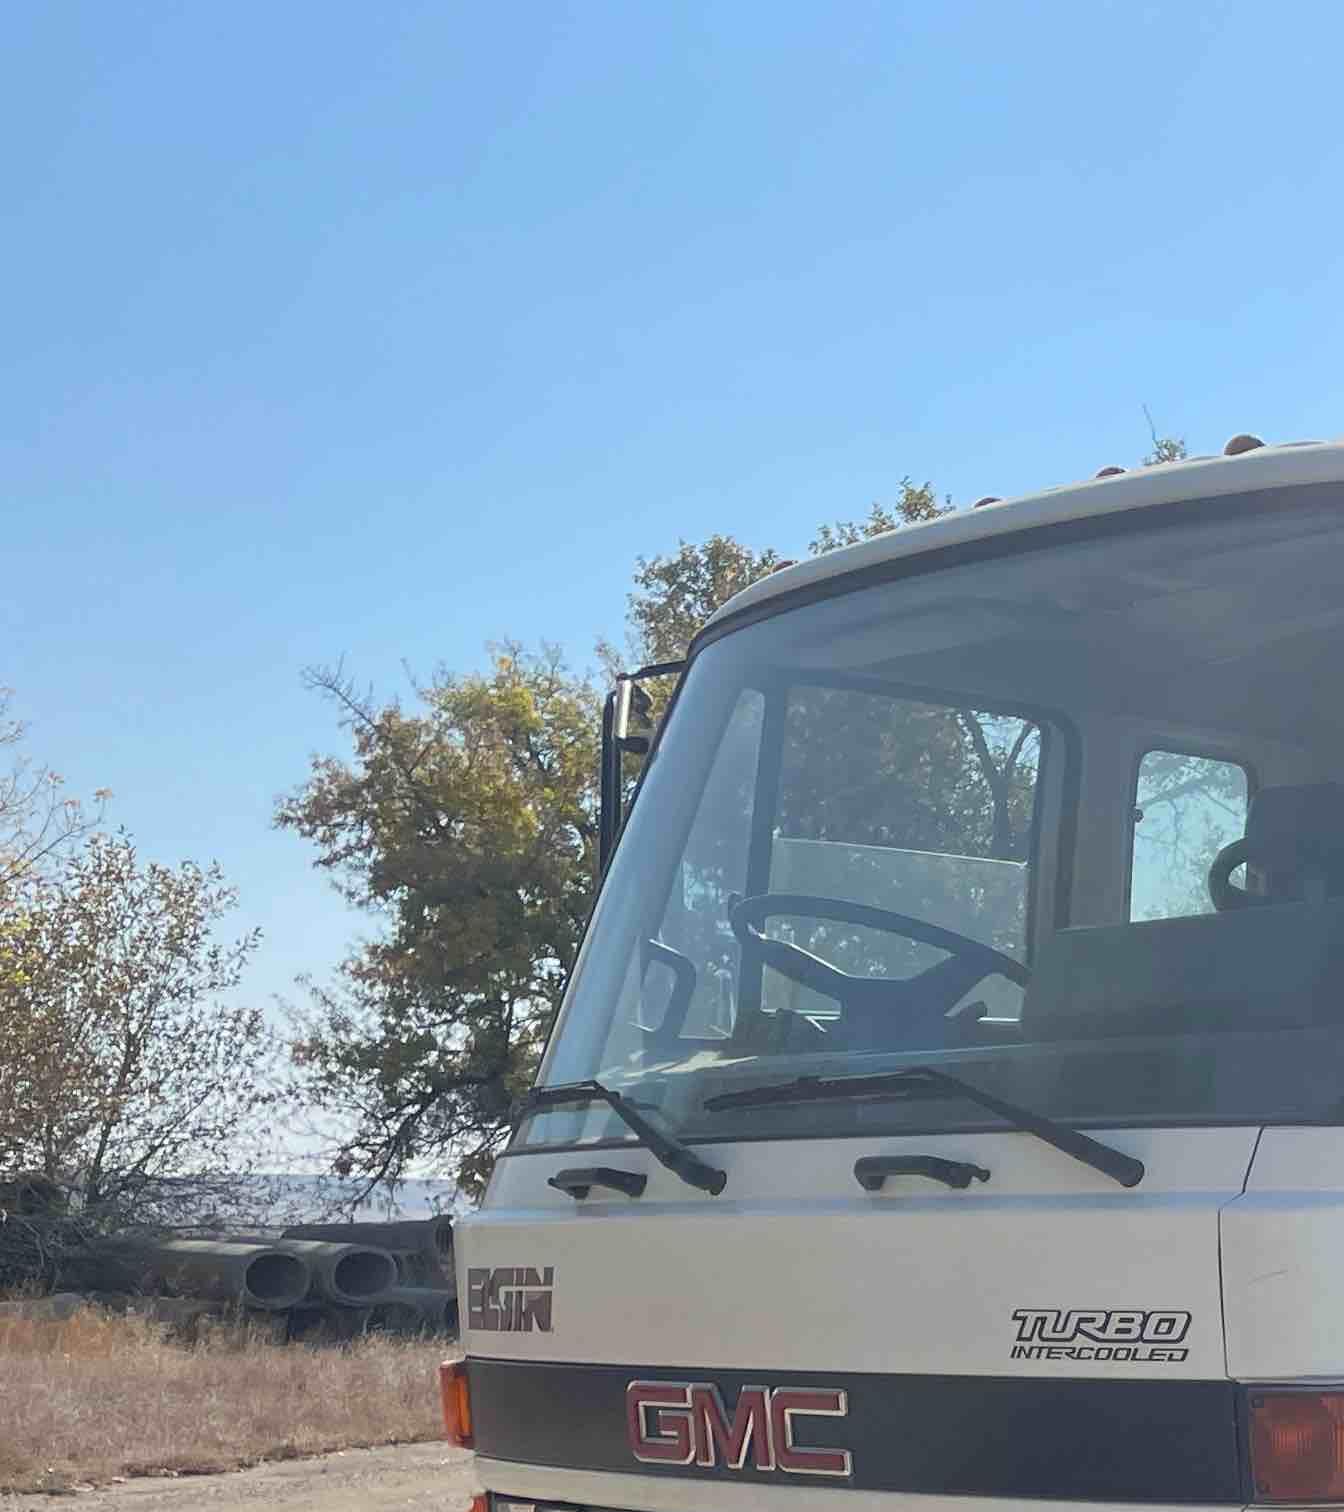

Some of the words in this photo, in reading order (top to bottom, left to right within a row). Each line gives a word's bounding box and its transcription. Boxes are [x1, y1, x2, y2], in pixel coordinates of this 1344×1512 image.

[468, 1266, 555, 1333] ELGIN
[1011, 1308, 1193, 1344] TURBO
[1010, 1345, 1189, 1362] INTERCOOLED
[627, 1380, 852, 1477] GMC
